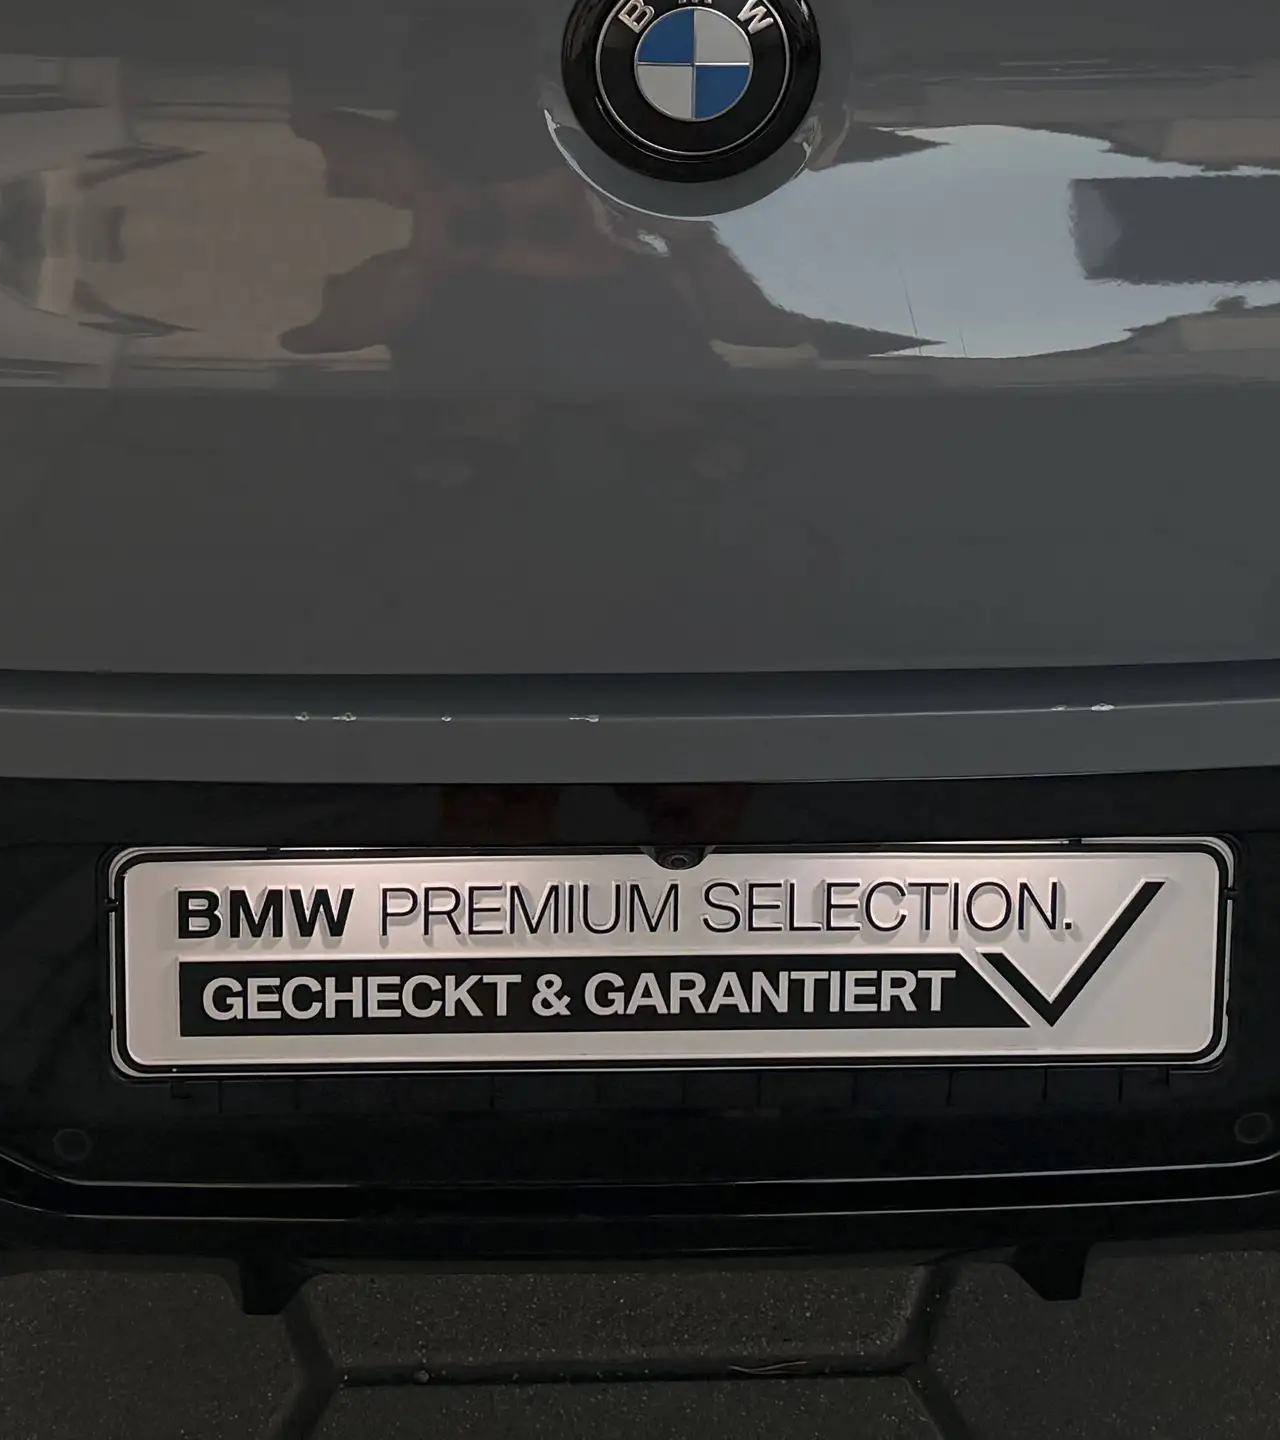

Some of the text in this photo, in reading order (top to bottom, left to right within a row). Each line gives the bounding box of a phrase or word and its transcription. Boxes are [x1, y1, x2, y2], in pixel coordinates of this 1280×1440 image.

[177, 880, 1073, 939] BMW PREMIUM SELECTION.
[202, 969, 957, 1021] GECHECKT & GARANTIERT
